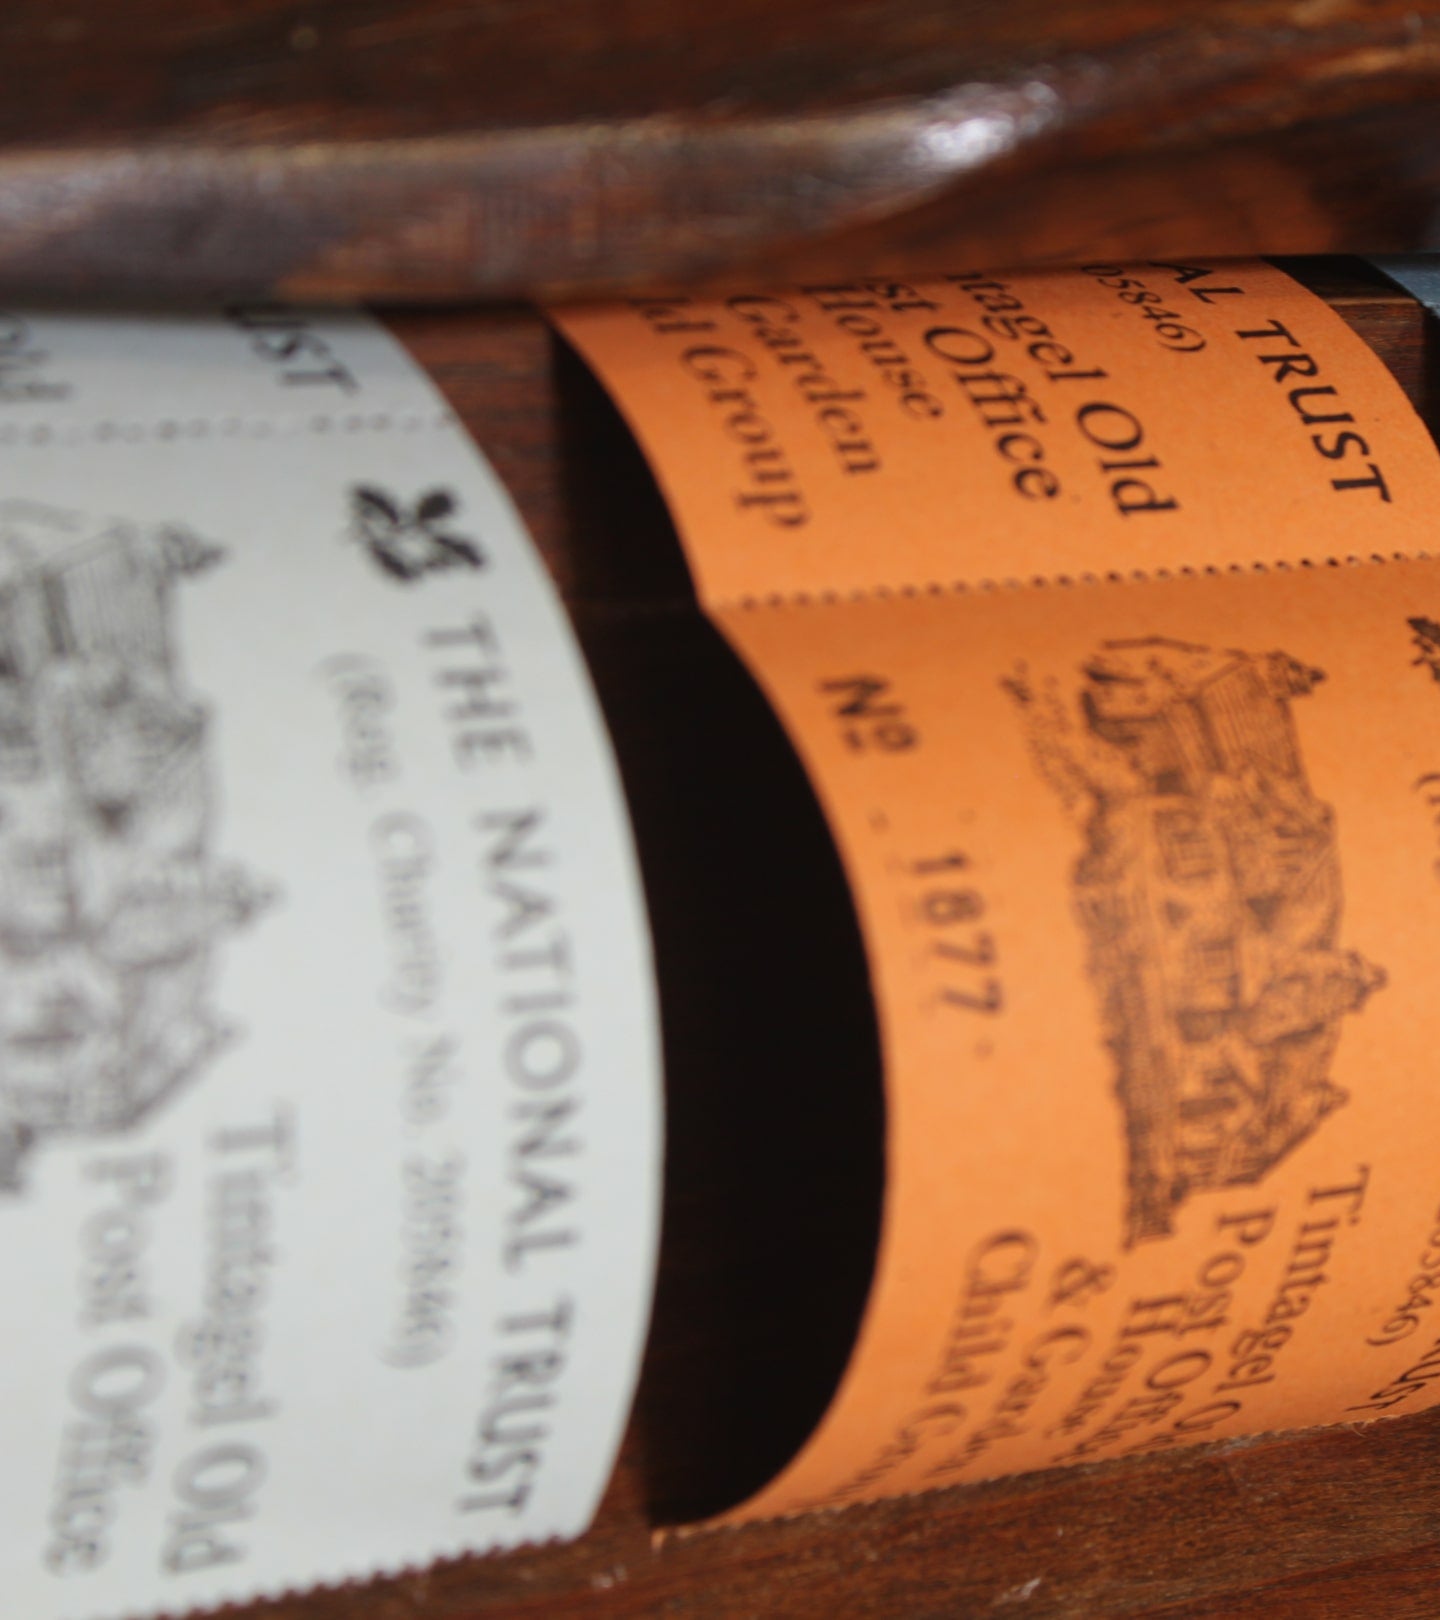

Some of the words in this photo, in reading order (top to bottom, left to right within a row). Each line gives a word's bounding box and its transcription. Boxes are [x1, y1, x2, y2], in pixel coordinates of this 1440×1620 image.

[682, 344, 810, 529] Group
[724, 294, 884, 477] Garden
[801, 283, 945, 422] House
[922, 323, 1063, 504] Office
[1234, 318, 1394, 504] TRUST
[1075, 399, 1180, 519] Old
[421, 611, 534, 770] THE
[470, 803, 584, 1275] NATIONAL
[79, 1151, 174, 1332] Post
[174, 1099, 297, 1428] Tintagel
[920, 1226, 1041, 1398] Child
[1048, 1256, 1117, 1312] &
[1173, 1206, 1278, 1340] Post
[1215, 1164, 1371, 1394] Tintagel
[41, 1343, 168, 1578] Office
[456, 1297, 575, 1515] TRUST
[160, 1437, 269, 1576] Old
